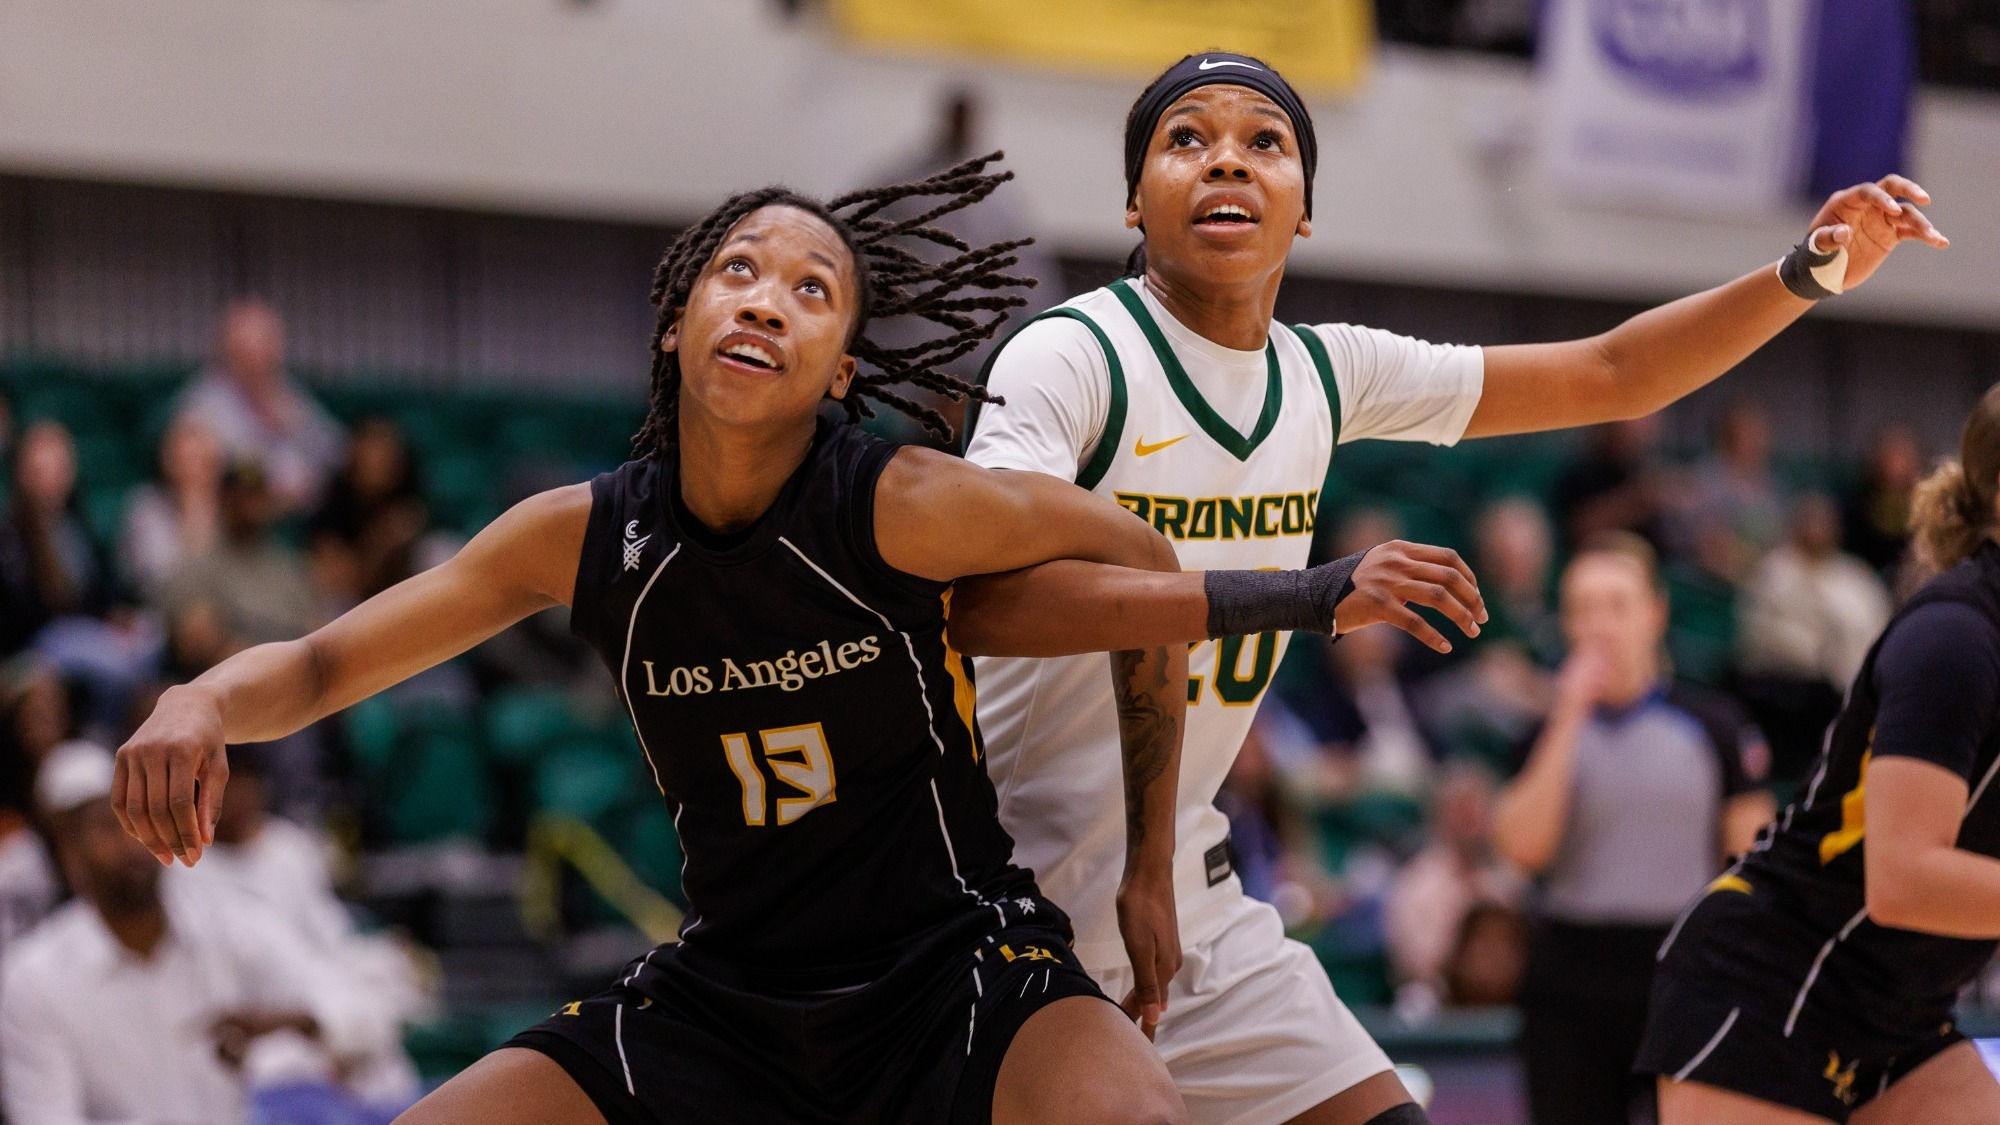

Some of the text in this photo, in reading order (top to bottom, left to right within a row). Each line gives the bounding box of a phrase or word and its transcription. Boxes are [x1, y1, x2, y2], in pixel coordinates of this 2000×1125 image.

[642, 635, 881, 696] Los Angeles
[720, 721, 837, 826] 13
